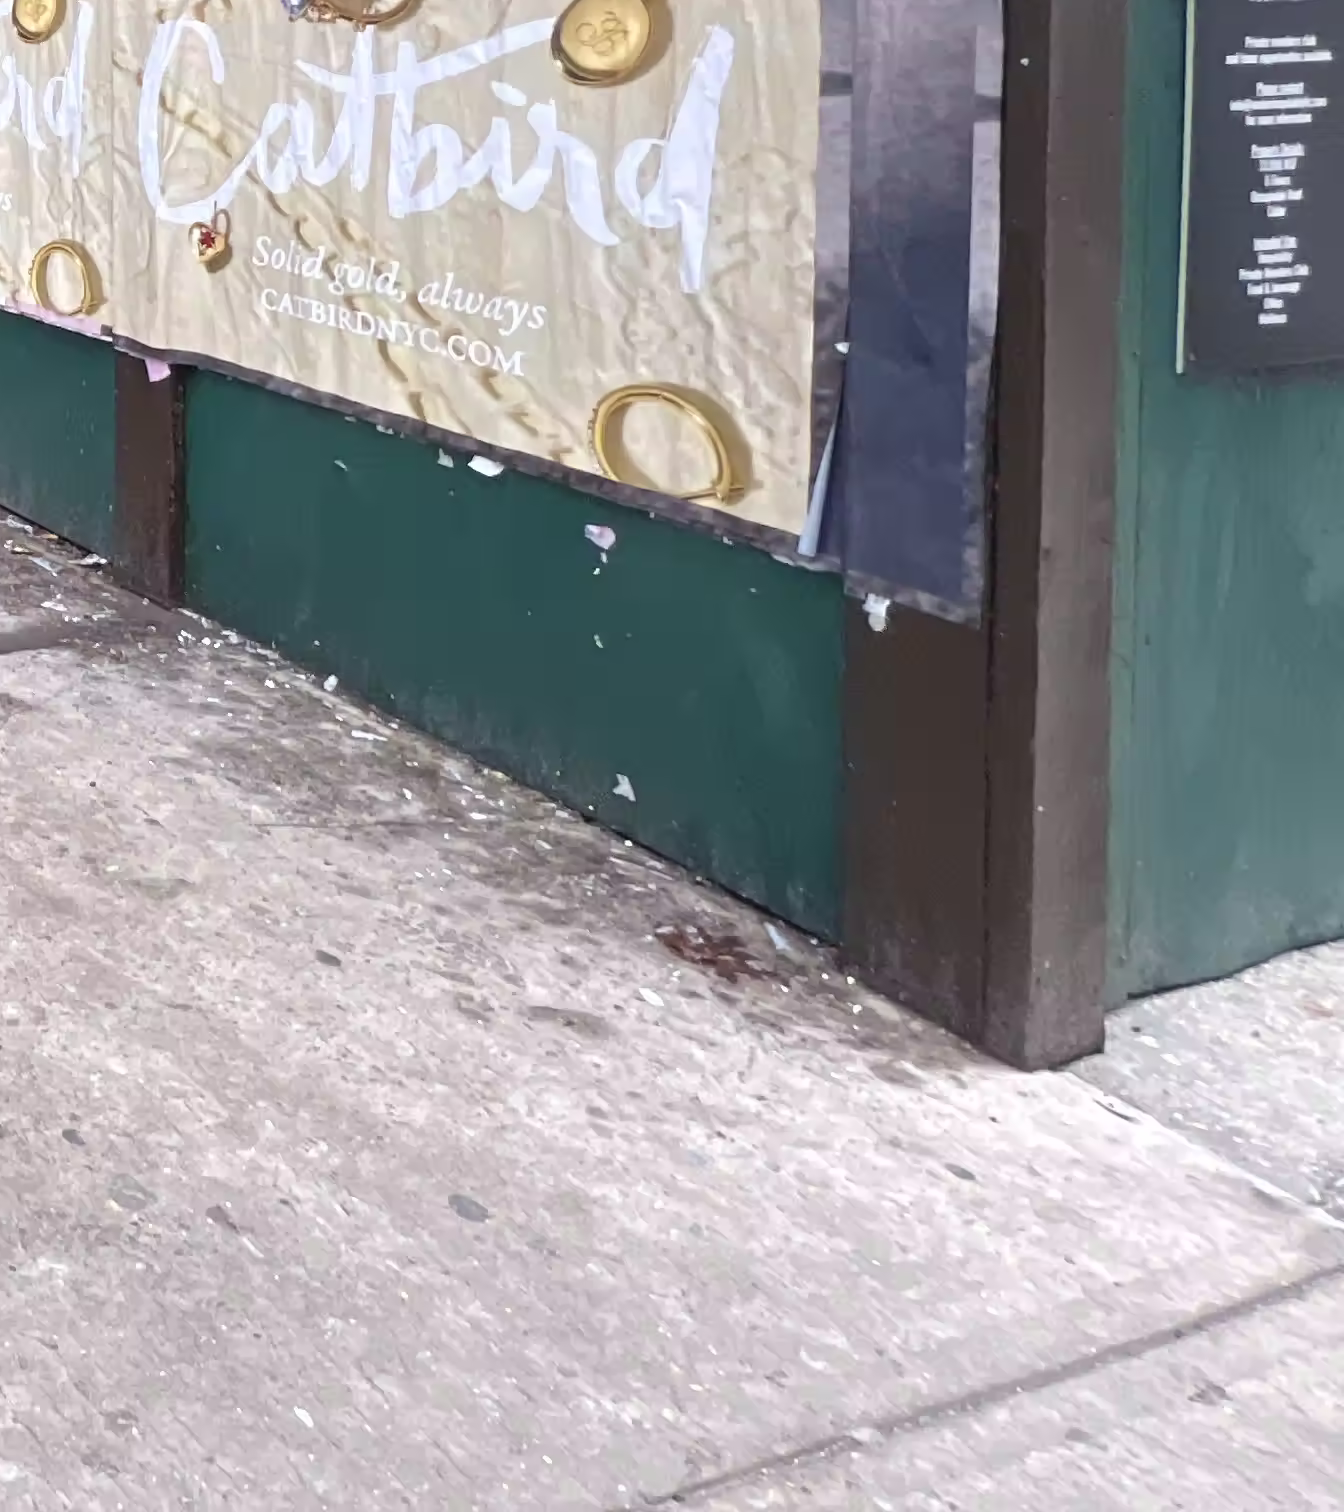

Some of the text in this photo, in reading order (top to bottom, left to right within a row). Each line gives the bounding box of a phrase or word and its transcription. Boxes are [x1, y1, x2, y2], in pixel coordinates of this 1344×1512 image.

[138, 16, 735, 294] Catbird
[252, 235, 548, 337] Solid gold, always
[261, 288, 525, 377] CATBIRDNYC.COM
